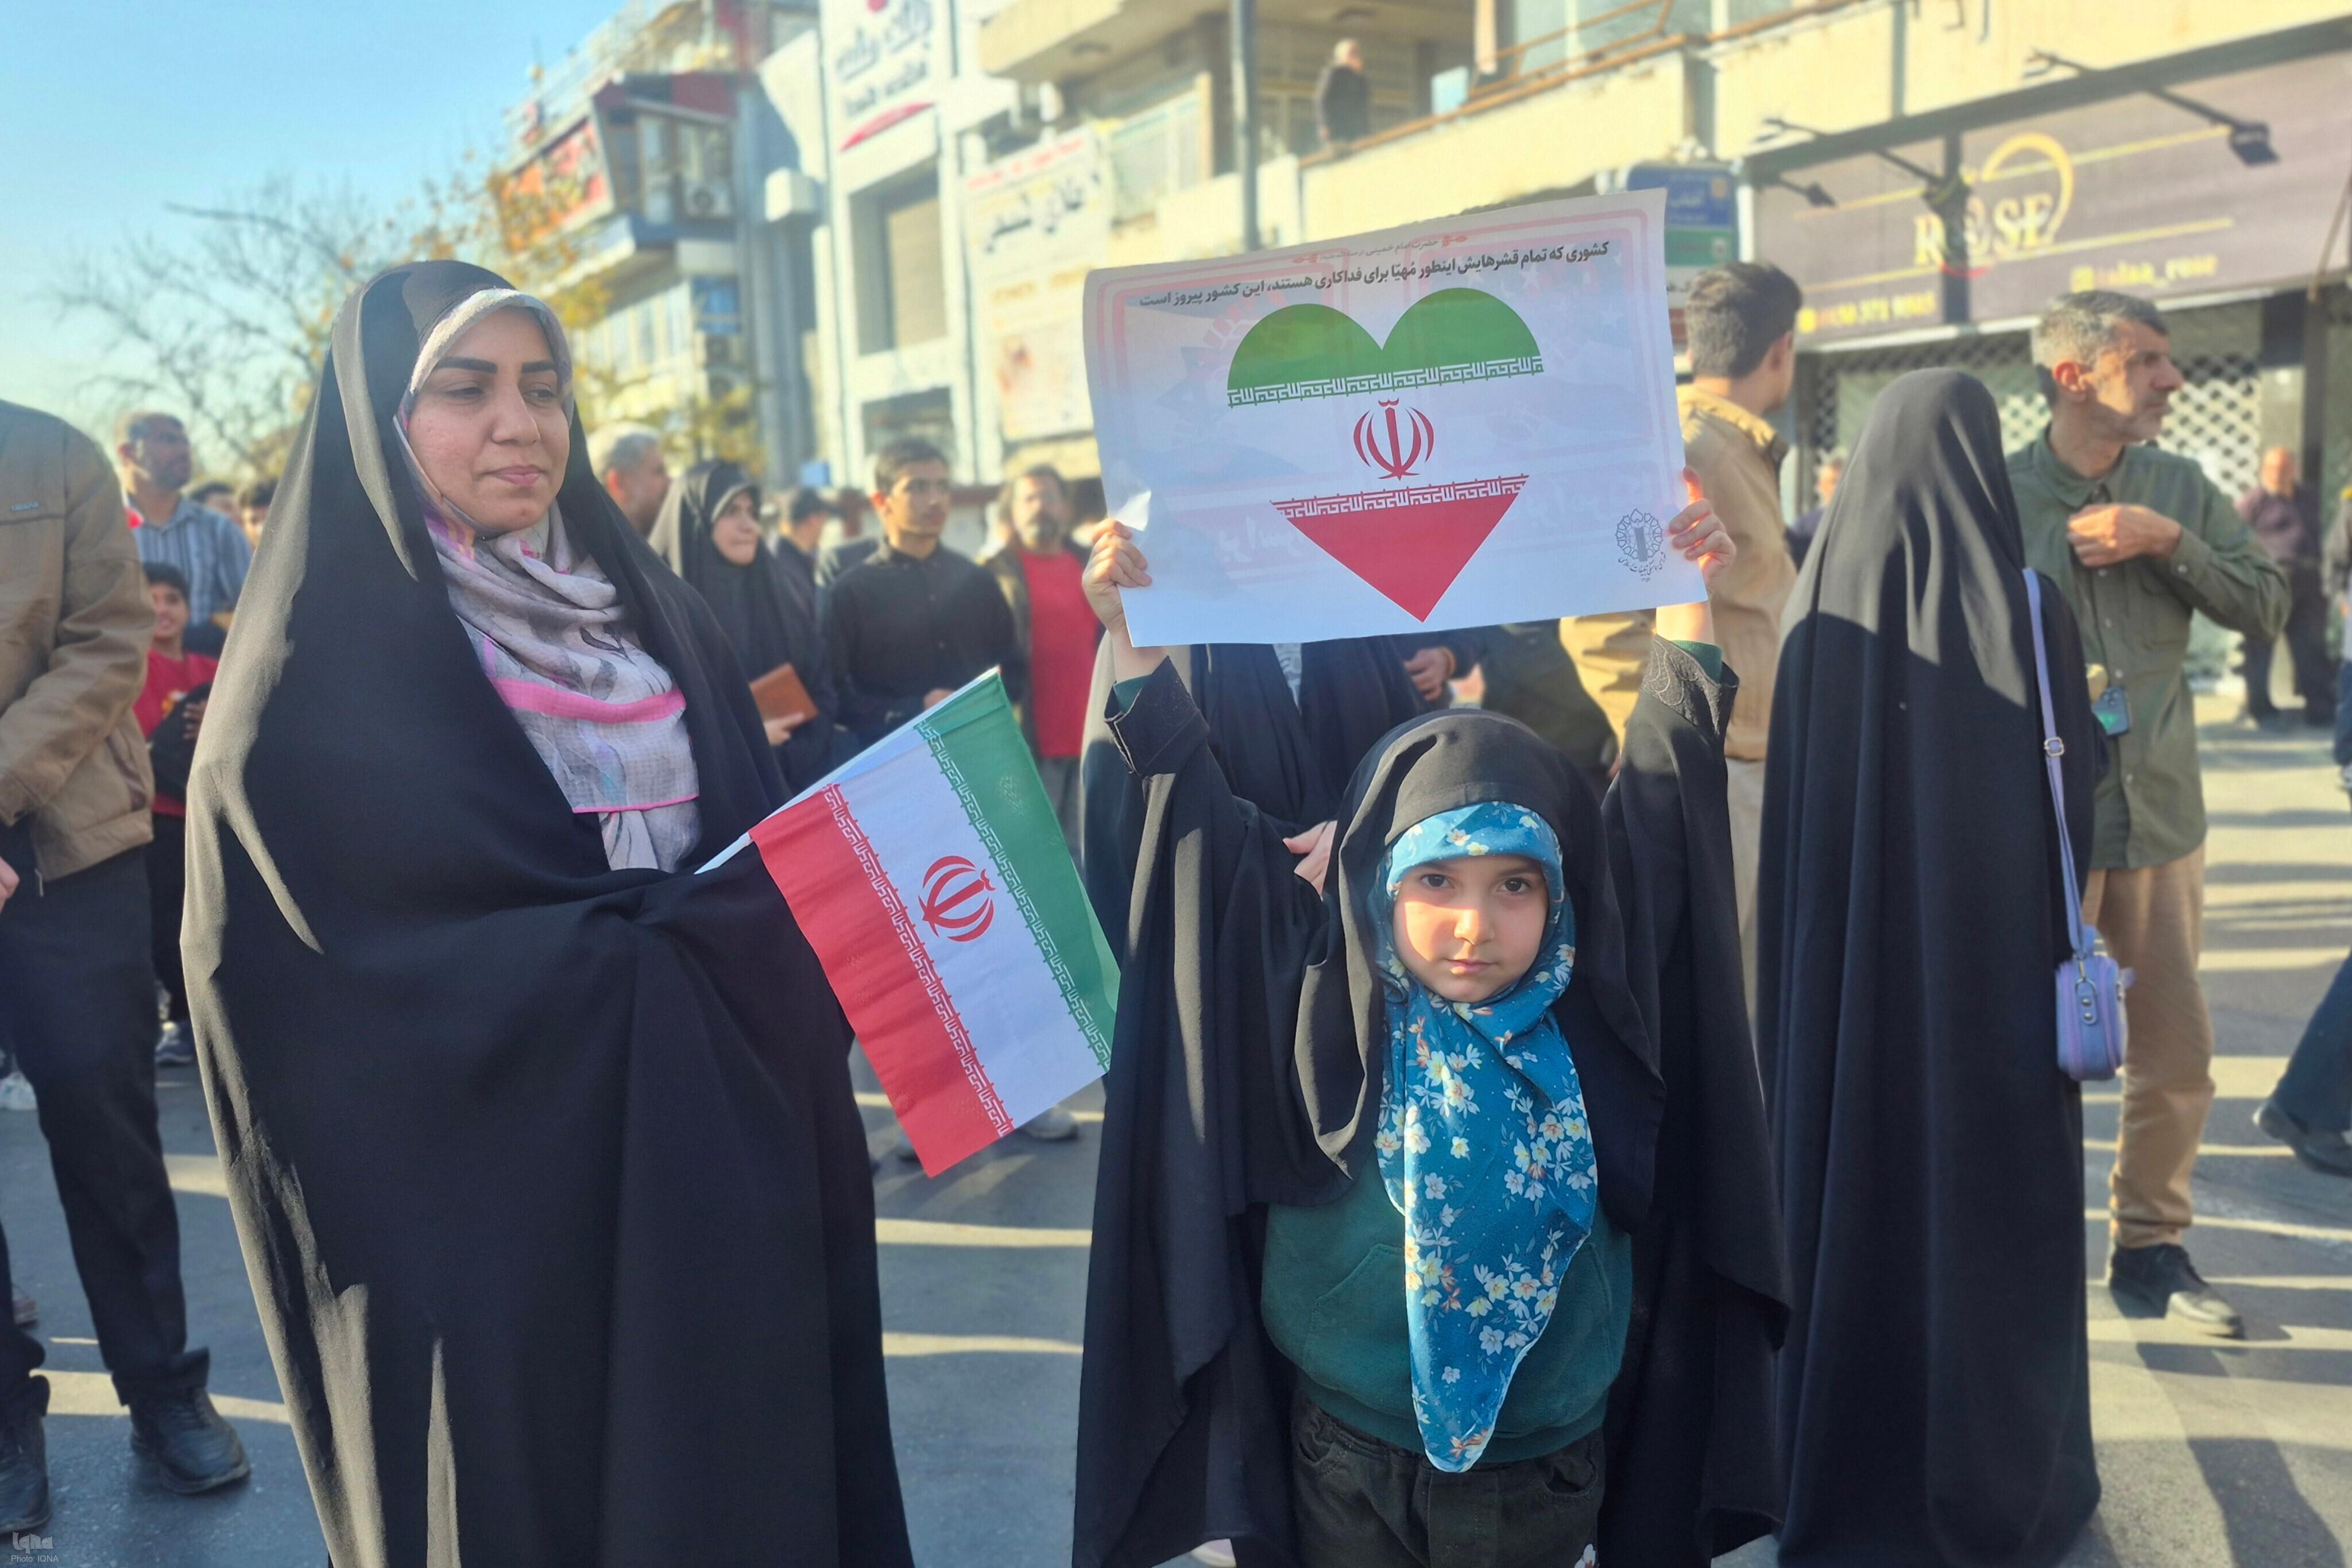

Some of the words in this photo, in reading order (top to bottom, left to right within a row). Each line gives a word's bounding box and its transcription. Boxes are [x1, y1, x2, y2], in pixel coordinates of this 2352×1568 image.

[1521, 248, 1548, 269] تمام
[1549, 245, 1564, 260] که
[1566, 241, 1609, 262] کشوری
[1418, 257, 1456, 279] اینطور
[1457, 249, 1519, 274] قشرهایش
[1267, 276, 1313, 291] هستند،
[1315, 270, 1362, 289] فداکاری
[1364, 266, 1388, 284] برای
[1173, 289, 1203, 306] پیروز
[1206, 283, 1240, 303] کشور
[1242, 280, 1264, 297] این
[1139, 291, 1171, 306] است
